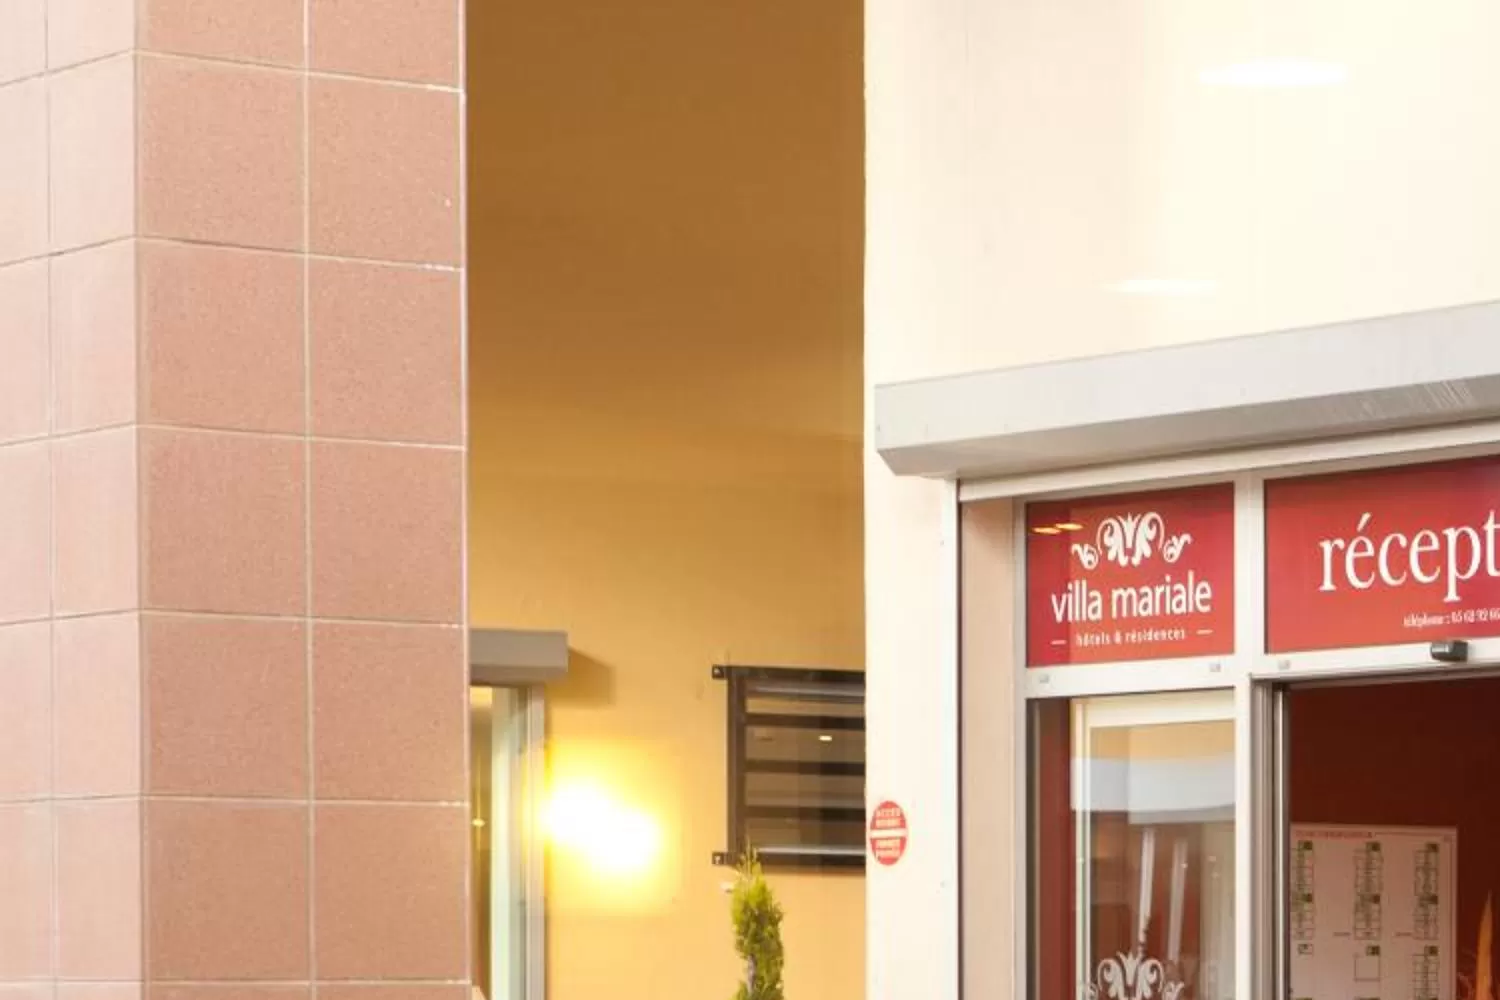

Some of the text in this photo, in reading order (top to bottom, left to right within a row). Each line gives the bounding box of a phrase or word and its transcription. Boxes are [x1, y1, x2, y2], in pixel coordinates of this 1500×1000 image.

[1051, 570, 1212, 624] villa mariale
[1125, 628, 1185, 643] résidences
